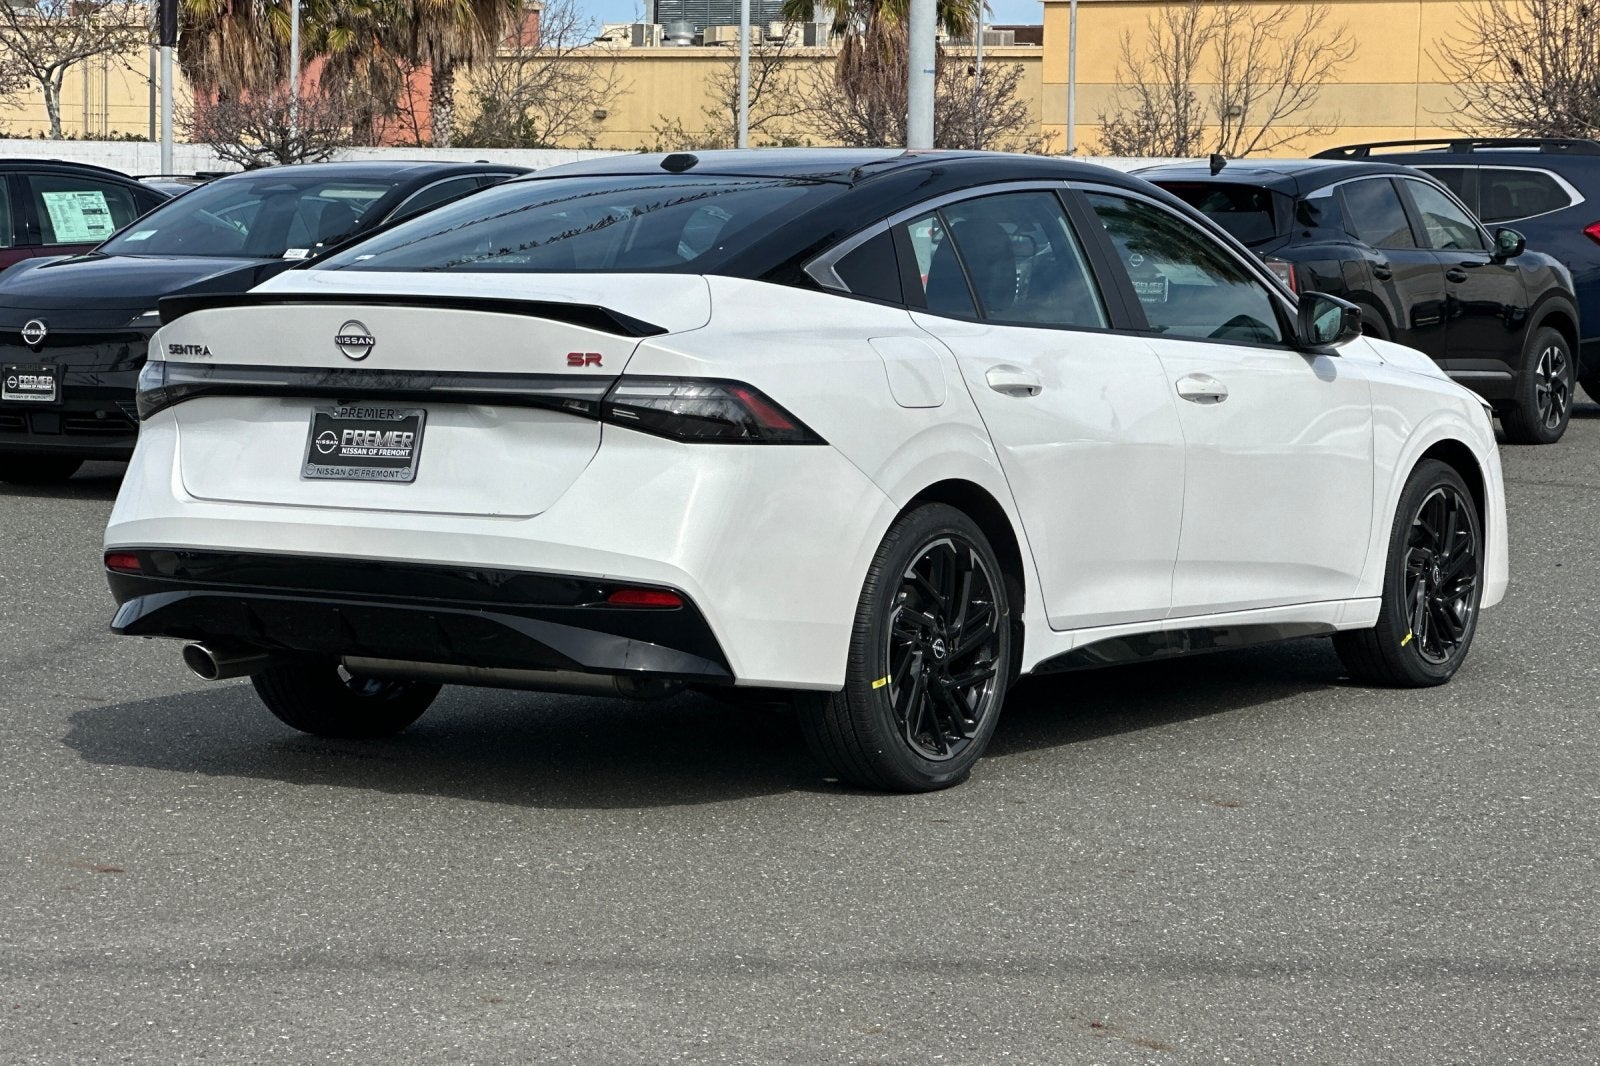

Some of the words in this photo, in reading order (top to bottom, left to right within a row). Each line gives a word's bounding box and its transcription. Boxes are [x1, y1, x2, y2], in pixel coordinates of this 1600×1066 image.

[335, 336, 374, 345] NISSAN
[168, 344, 212, 356] SENTRA
[567, 352, 603, 367] SR
[18, 375, 53, 385] PREMIER
[340, 407, 395, 419] PREMIER
[341, 429, 414, 448] PREMIER
[368, 448, 377, 456] OF
[379, 449, 410, 457] FREMONT
[316, 468, 346, 476] NISSAN
[361, 469, 400, 478] FREMONT
